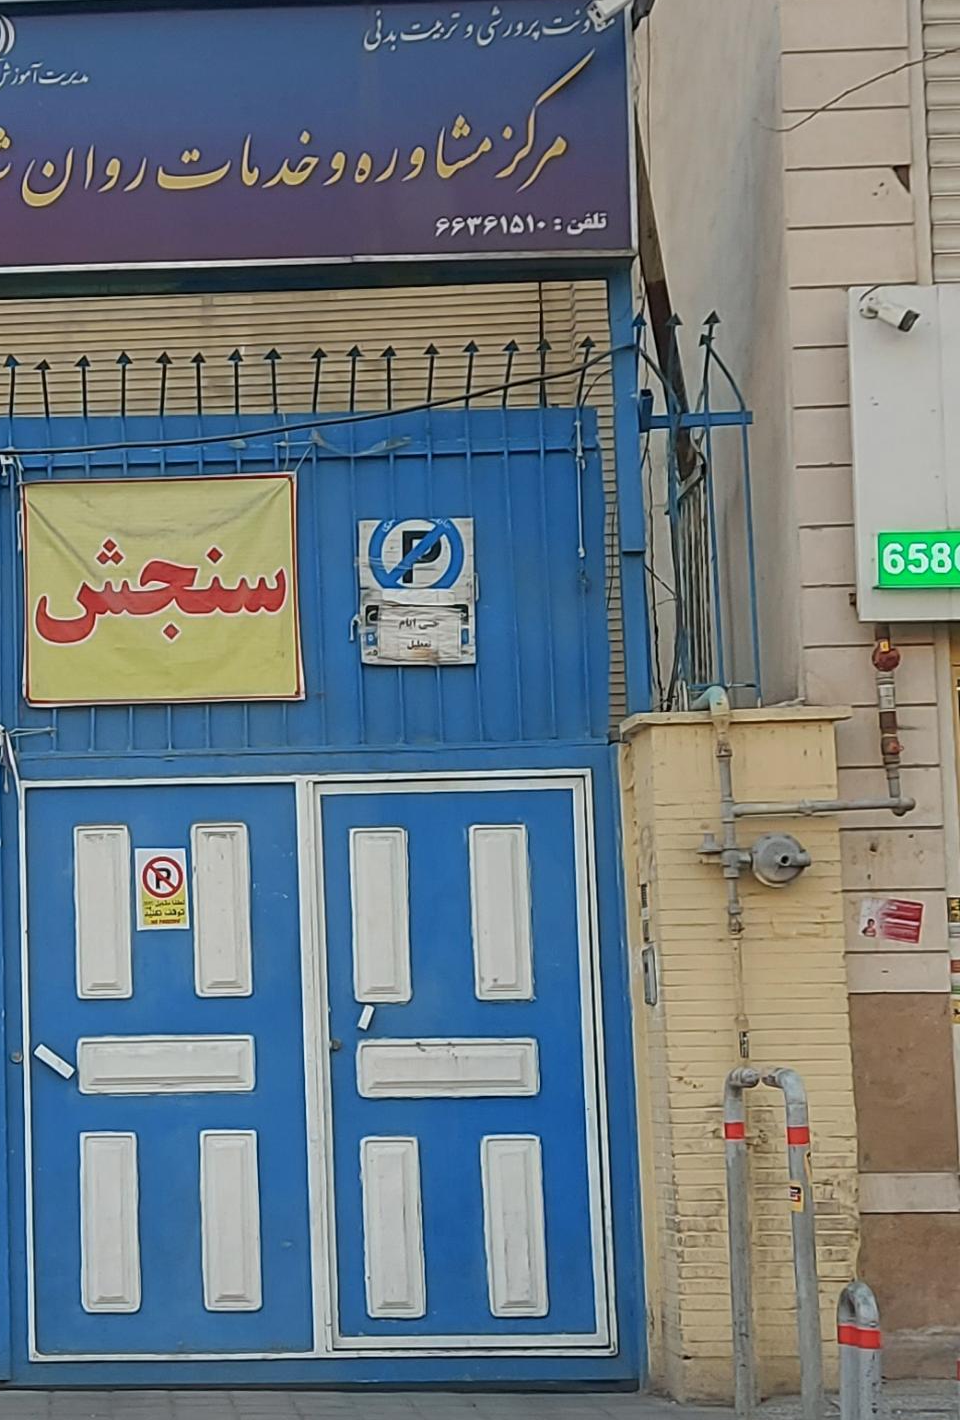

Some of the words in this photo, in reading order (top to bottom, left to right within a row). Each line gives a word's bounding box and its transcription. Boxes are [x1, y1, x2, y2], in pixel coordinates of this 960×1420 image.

[363, 10, 398, 52] بدنی
[400, 12, 460, 42] تربیت
[463, 16, 474, 40] و
[476, 5, 540, 46] پرورشی
[39, 70, 90, 86] مدیریت
[493, 47, 596, 194] مرکز
[156, 130, 320, 189] خدمات
[353, 114, 493, 184] مشاوره
[322, 151, 347, 186] و
[435, 214, 546, 236] ۶۶۳۶۱۵۱۰
[566, 212, 607, 235] تلفن
[883, 542, 960, 575] 658
[35, 537, 287, 644] سنجش
